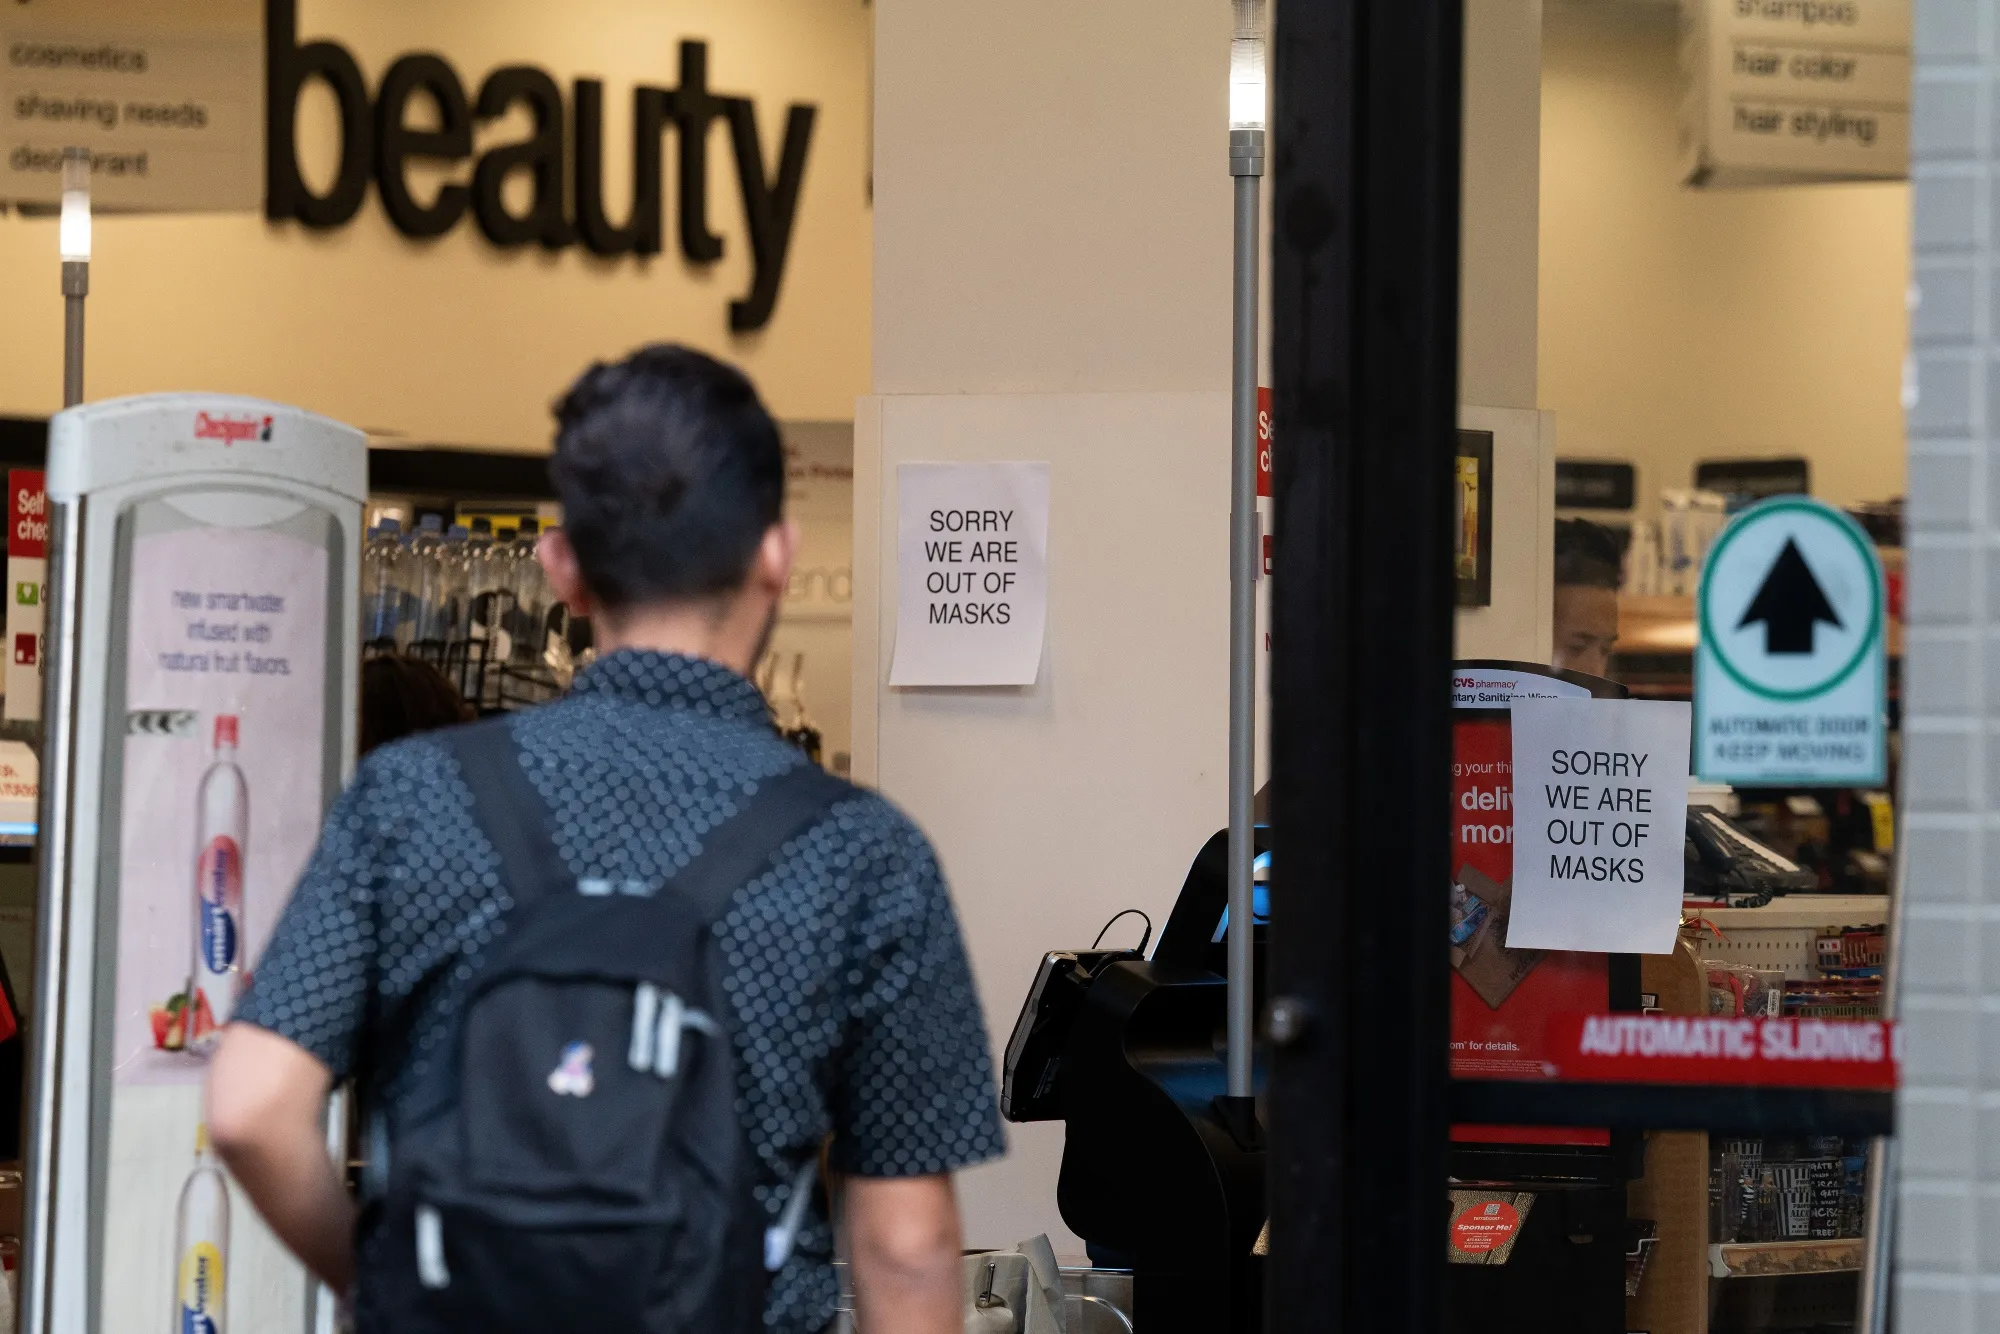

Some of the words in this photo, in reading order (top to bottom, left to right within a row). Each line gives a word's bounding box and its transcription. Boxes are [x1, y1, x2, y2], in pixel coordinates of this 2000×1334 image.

[9, 43, 148, 73] cosmetics
[1733, 50, 1781, 77] hair
[1789, 54, 1856, 80] color
[15, 91, 118, 130] shaving
[124, 101, 208, 129] needs
[1733, 103, 1782, 133] hair
[1791, 110, 1877, 145] styling
[266, 0, 817, 332] beauty
[929, 510, 1014, 532] SORRY
[924, 541, 963, 563] WE
[970, 541, 1018, 563] ARE
[926, 572, 976, 594] OUT
[983, 572, 1016, 594] OF
[929, 603, 1011, 625] MASKS
[1453, 678, 1474, 687] CVS
[1476, 680, 1516, 690] pharmacy
[1710, 715, 1808, 734] AUTOMATIC
[1551, 750, 1648, 777] SORRY
[1716, 741, 1769, 761] KEEP
[1777, 741, 1866, 763] MOVING
[1465, 763, 1494, 775] your
[1545, 784, 1589, 810] WE
[1597, 787, 1652, 813] ARE
[1547, 819, 1605, 846] OUT
[1612, 822, 1650, 848] OF
[1550, 855, 1644, 883] MASKS
[1469, 1041, 1482, 1050] for
[1485, 1041, 1520, 1051] details.
[1580, 1016, 1755, 1059] AUTOMATIC
[1759, 1019, 1884, 1062] SLIDING
